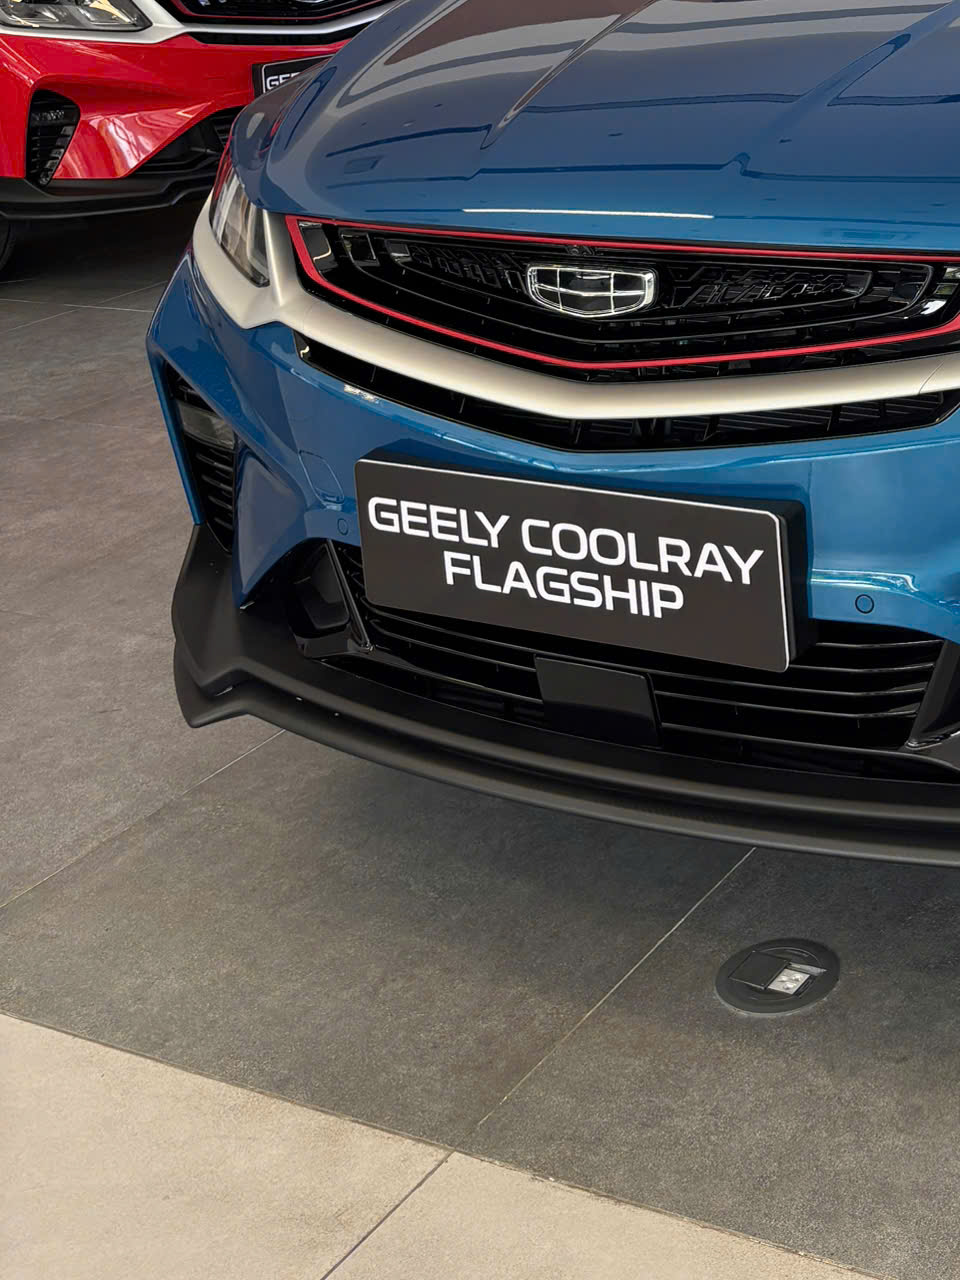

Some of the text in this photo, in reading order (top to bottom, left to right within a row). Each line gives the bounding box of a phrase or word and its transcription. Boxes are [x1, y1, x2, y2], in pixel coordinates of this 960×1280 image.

[368, 496, 764, 584] GEELY COOLRAY
[443, 550, 684, 618] FLAGSHIP
